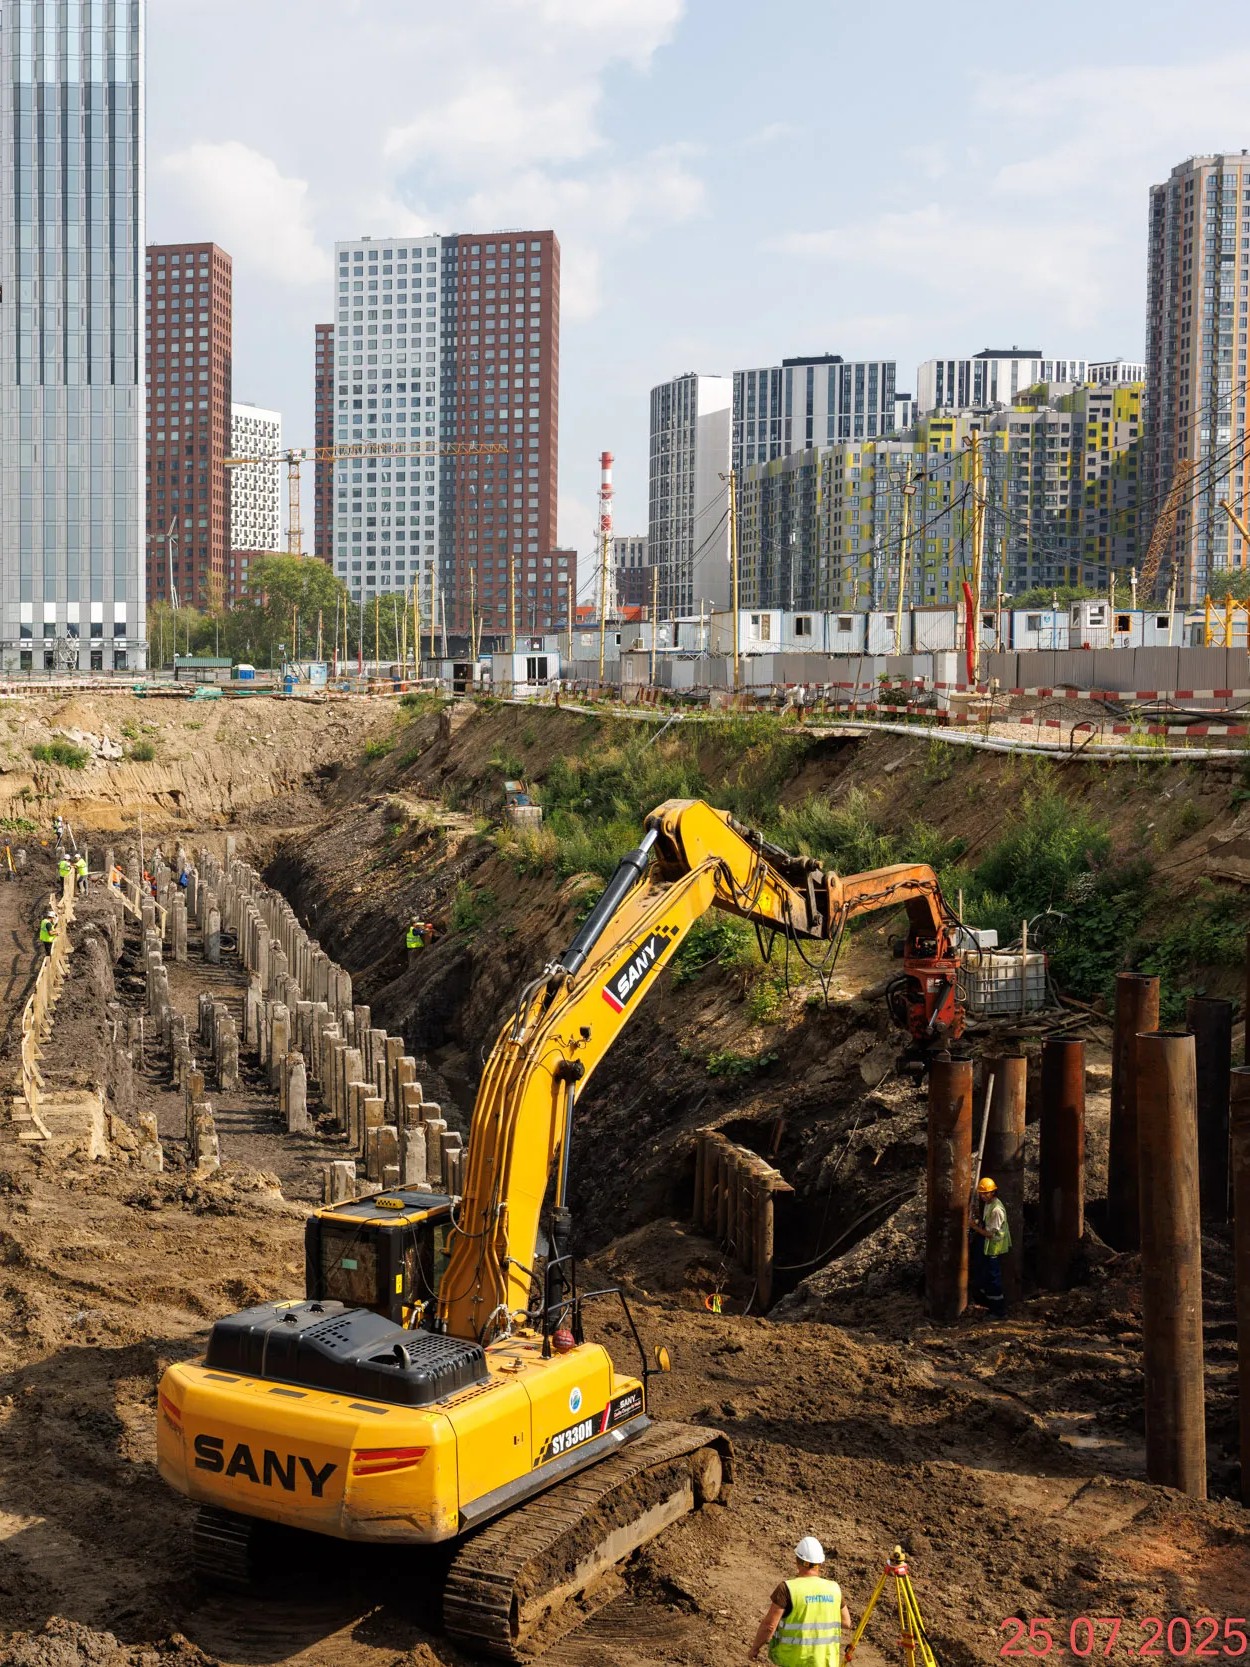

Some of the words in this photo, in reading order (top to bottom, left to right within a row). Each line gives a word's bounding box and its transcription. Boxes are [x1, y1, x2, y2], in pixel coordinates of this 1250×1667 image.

[617, 937, 655, 1000] SANY
[620, 1395, 636, 1408] SANY
[552, 1419, 593, 1455] SY330H
[194, 1434, 338, 1497] SANY
